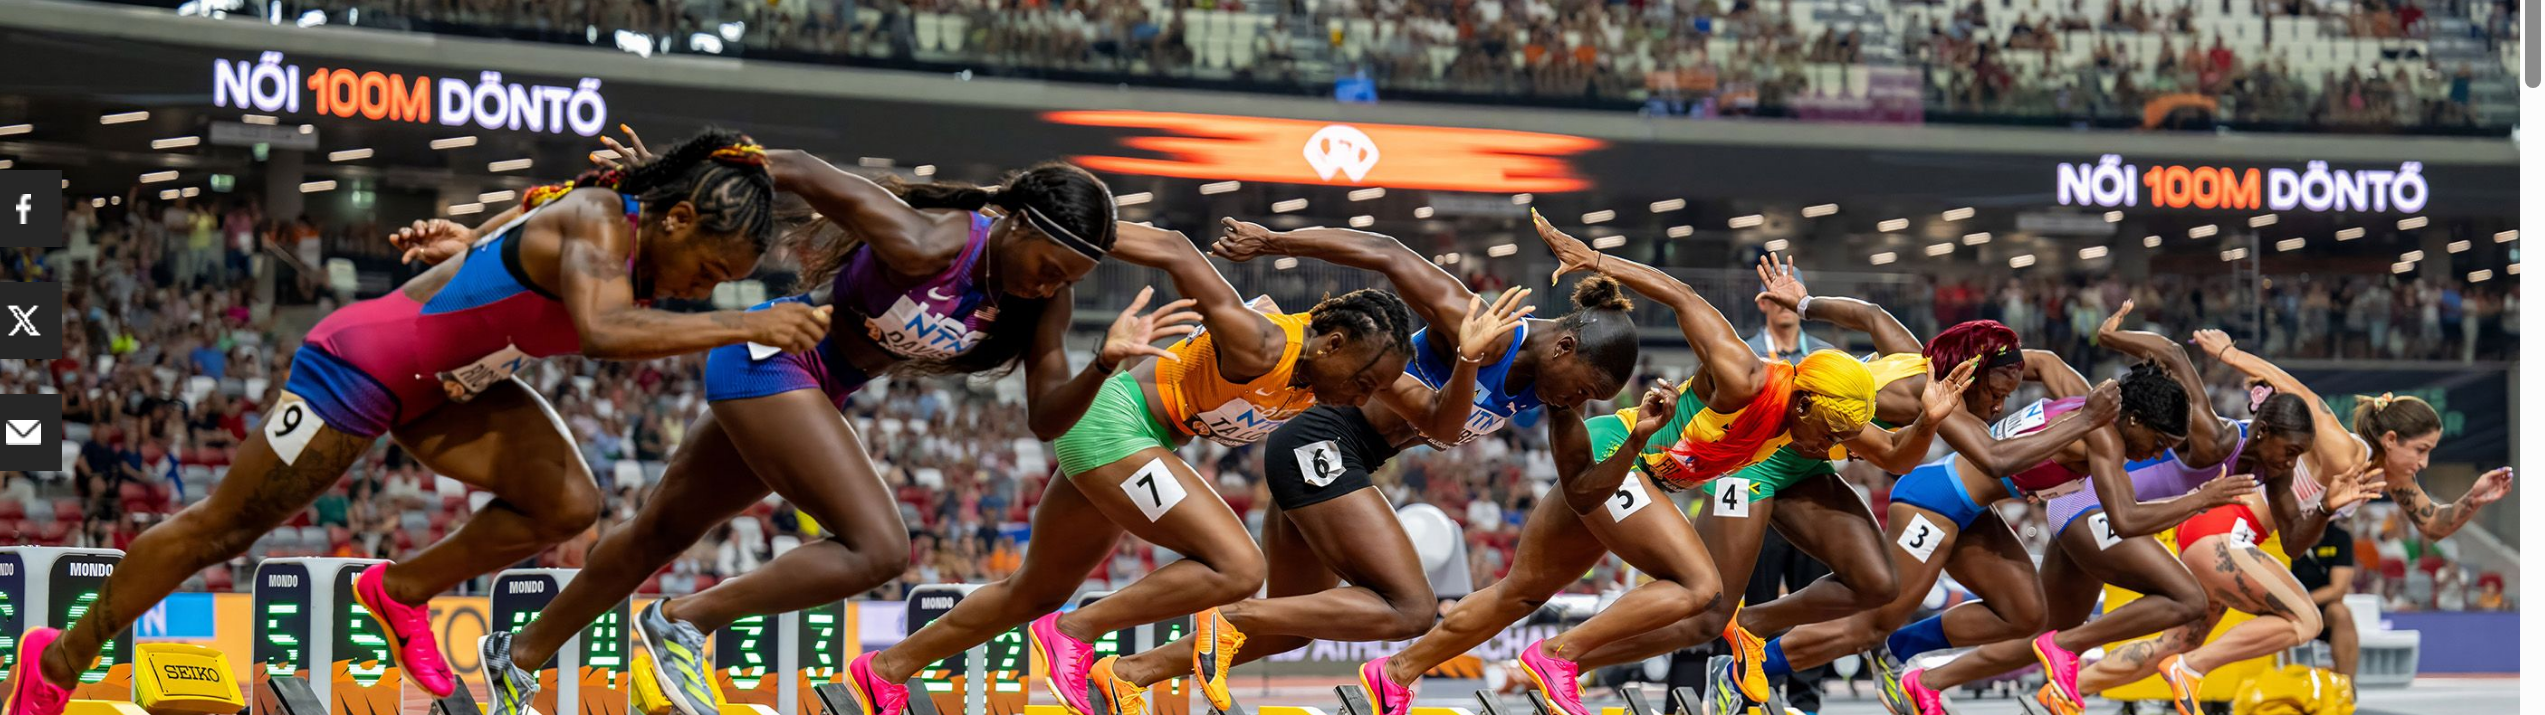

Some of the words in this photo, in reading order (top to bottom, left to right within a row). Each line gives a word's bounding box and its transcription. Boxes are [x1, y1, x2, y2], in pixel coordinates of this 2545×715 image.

[213, 50, 300, 113] NŐI
[307, 67, 431, 124] 100M
[438, 70, 607, 137] DÖNTŐ
[2057, 153, 2138, 207] NŐI
[2143, 165, 2262, 210] 100M
[2267, 160, 2430, 214] DÖNTŐ
[274, 404, 303, 438] 9
[1210, 417, 1241, 437] TA
[1313, 448, 1330, 479] 6
[1136, 471, 1162, 508] 7
[1615, 488, 1634, 510] 5
[1722, 484, 1737, 510] 4
[1909, 524, 1930, 549] 3
[2098, 516, 2116, 541] 2
[0, 563, 14, 577] NDO
[70, 563, 114, 577] MONDO
[268, 574, 298, 588] MONDO
[509, 580, 545, 594] MONDO
[921, 596, 954, 610] MONDO
[266, 604, 298, 676] 5
[349, 604, 387, 687] 5
[589, 612, 620, 690] 4
[728, 615, 765, 690] 3
[805, 614, 834, 687] 3
[164, 664, 220, 683] SEIKO
